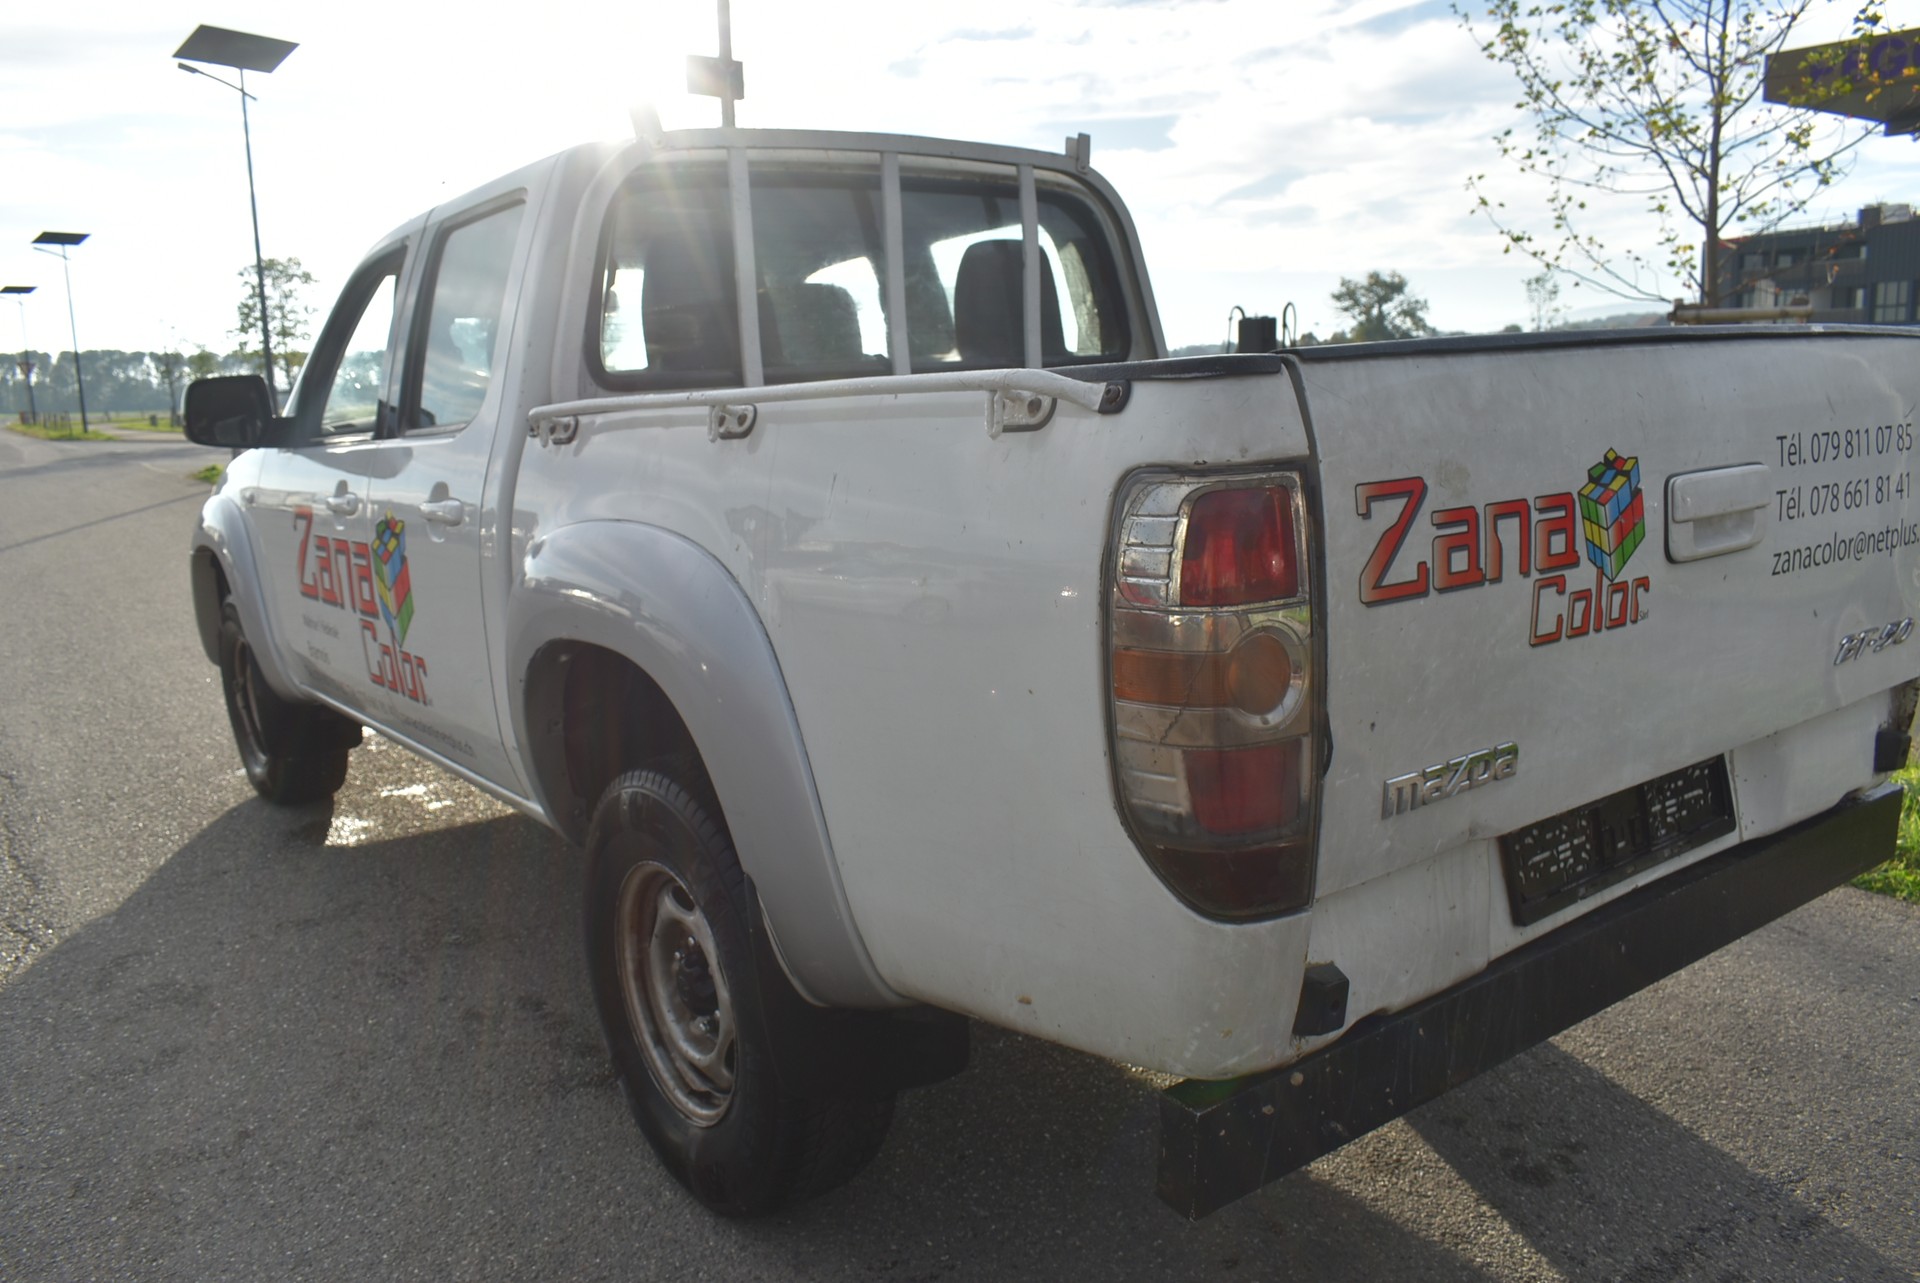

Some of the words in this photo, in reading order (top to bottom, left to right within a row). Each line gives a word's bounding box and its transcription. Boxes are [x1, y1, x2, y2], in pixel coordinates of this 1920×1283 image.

[1776, 432, 1806, 467] Tél.
[1811, 431, 1840, 463] 079
[1845, 428, 1870, 459] 811
[1876, 425, 1892, 454] 07
[1897, 423, 1912, 452] 85
[1776, 486, 1805, 522] Tél.
[1810, 483, 1839, 516] 078
[1844, 478, 1869, 510] 661
[1875, 475, 1890, 504] 81
[1896, 472, 1910, 500] 41
[294, 504, 379, 620] Zana
[1355, 476, 1579, 605] Zana
[1529, 567, 1650, 646] Color
[360, 618, 427, 706] Color
